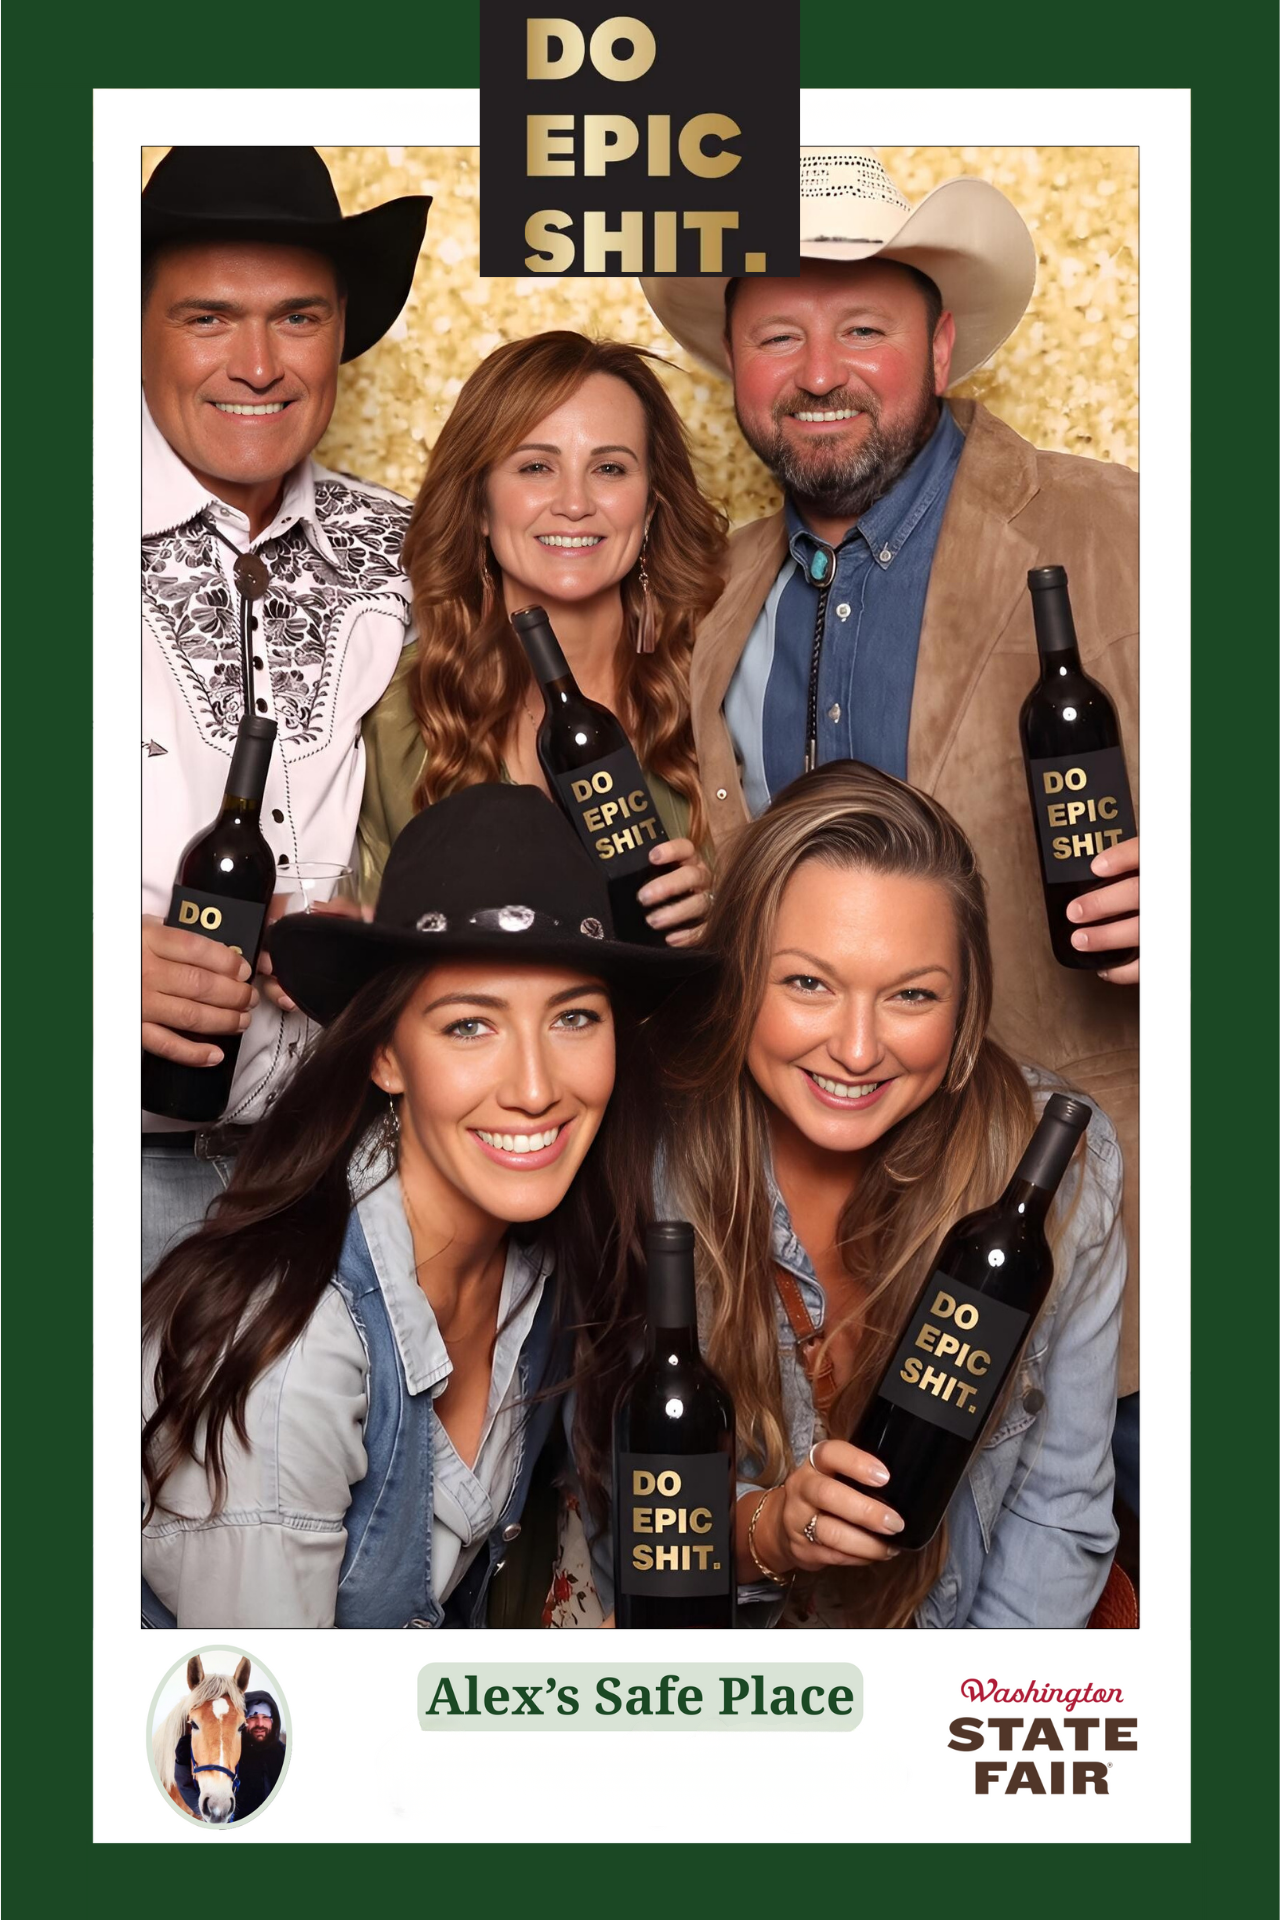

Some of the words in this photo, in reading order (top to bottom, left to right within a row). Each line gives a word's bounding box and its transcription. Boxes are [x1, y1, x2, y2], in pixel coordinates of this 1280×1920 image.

[570, 770, 614, 803] DO
[1042, 767, 1088, 794] DO
[582, 789, 648, 833] EPIC
[1047, 796, 1119, 828] EPIC
[178, 900, 223, 930] DO
[929, 1290, 980, 1330] DO
[914, 1323, 992, 1377] EPIC
[899, 1357, 978, 1415] SHIT.
[632, 1469, 682, 1497] DO
[632, 1507, 713, 1534] EPIC
[632, 1544, 721, 1571] SHIT.
